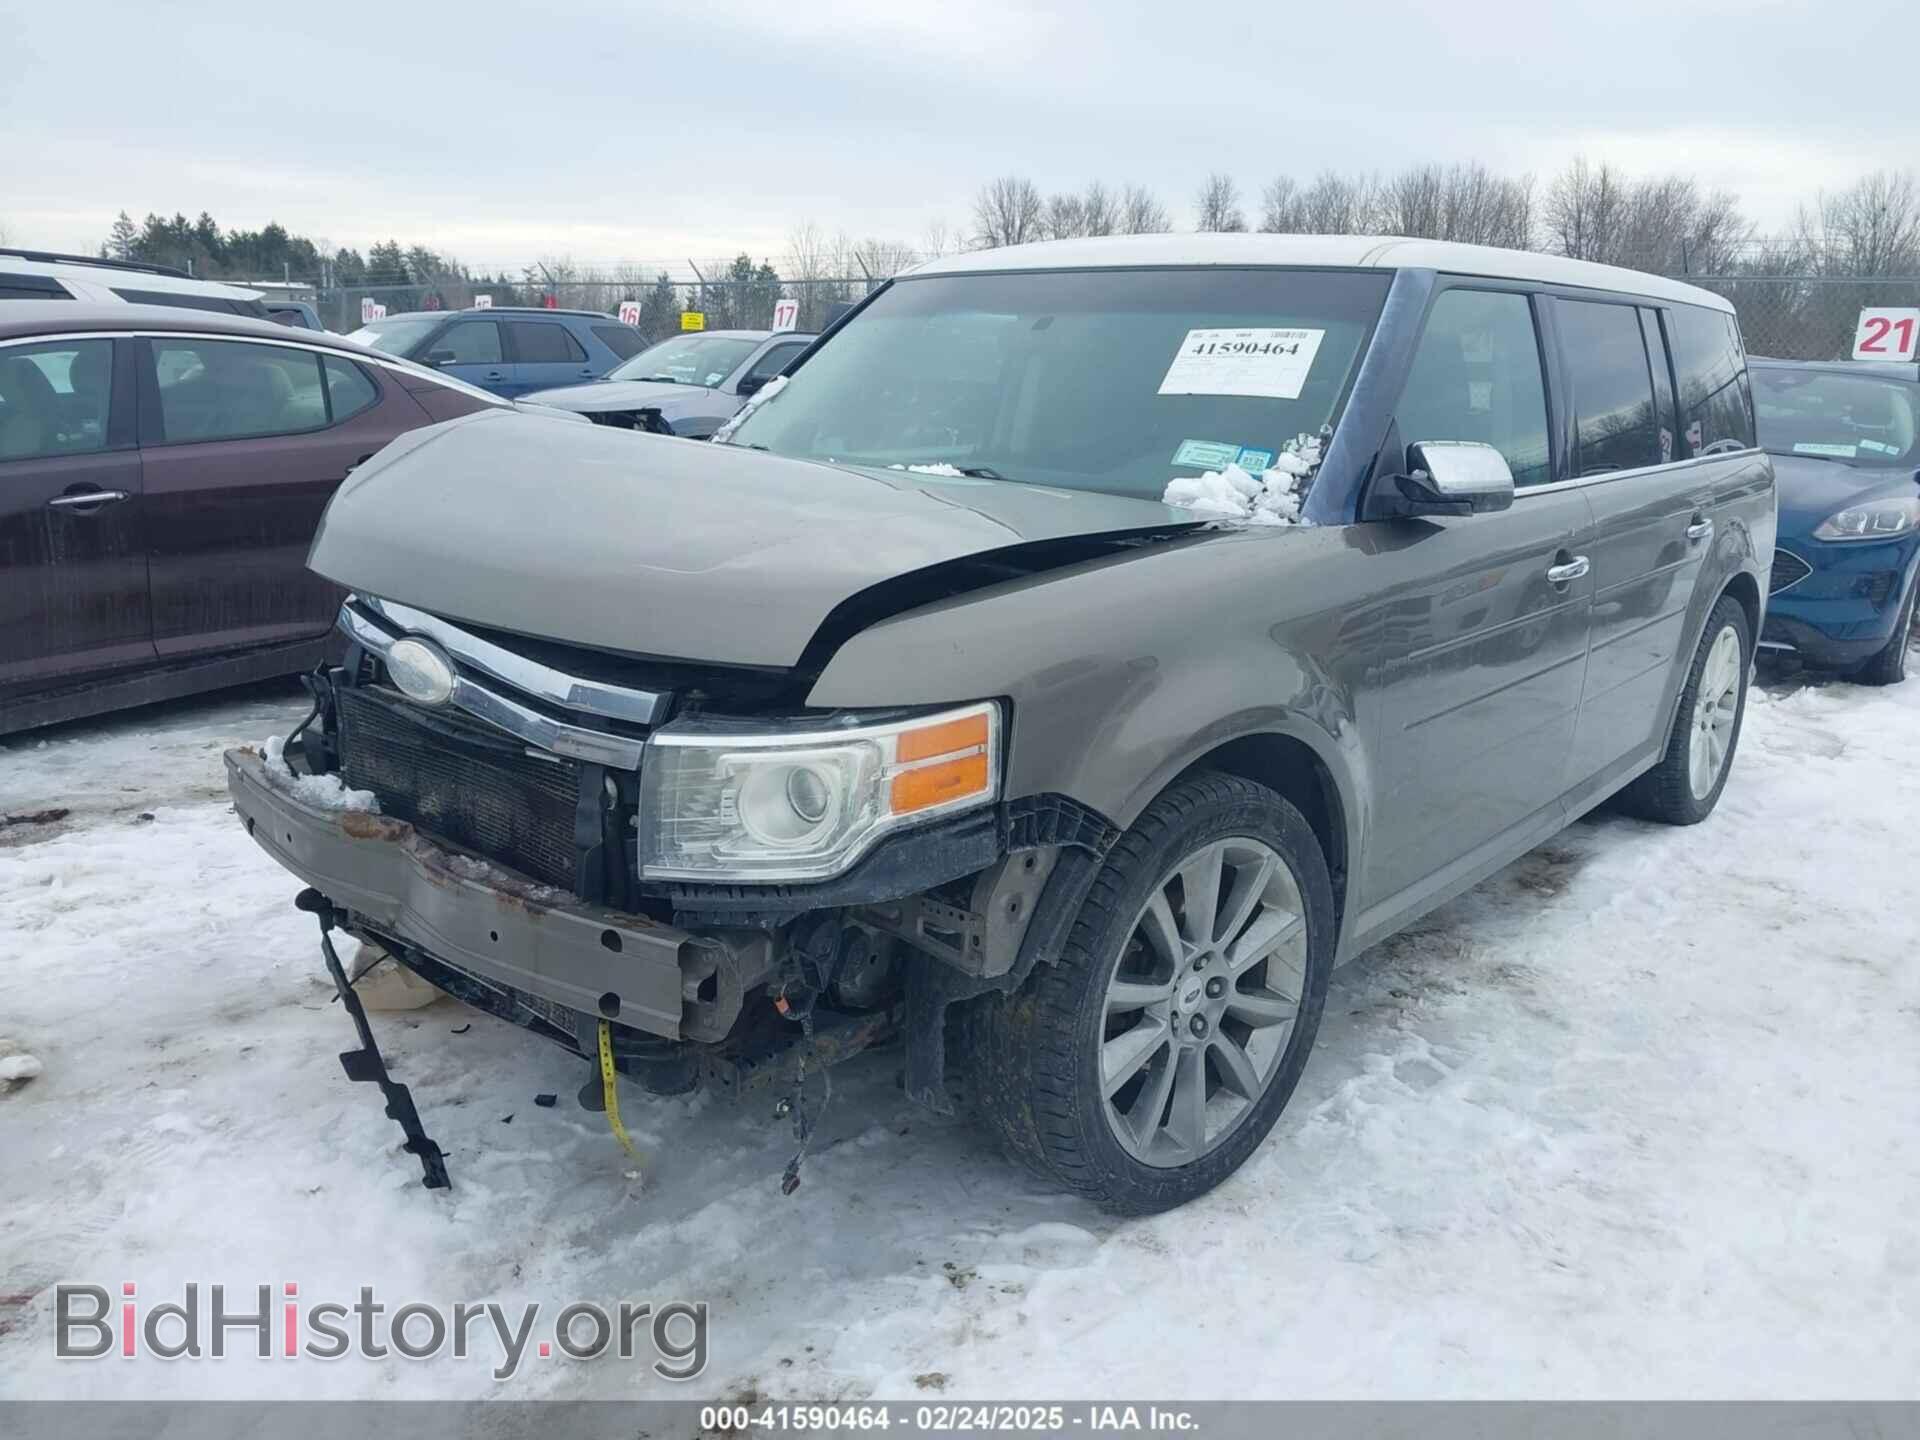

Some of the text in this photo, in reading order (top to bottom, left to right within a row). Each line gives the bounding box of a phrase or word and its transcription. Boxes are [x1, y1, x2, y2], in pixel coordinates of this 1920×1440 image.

[621, 307, 639, 325] 16
[777, 305, 796, 327] 17
[1859, 317, 1914, 353] 21
[1191, 341, 1300, 356] 41590464
